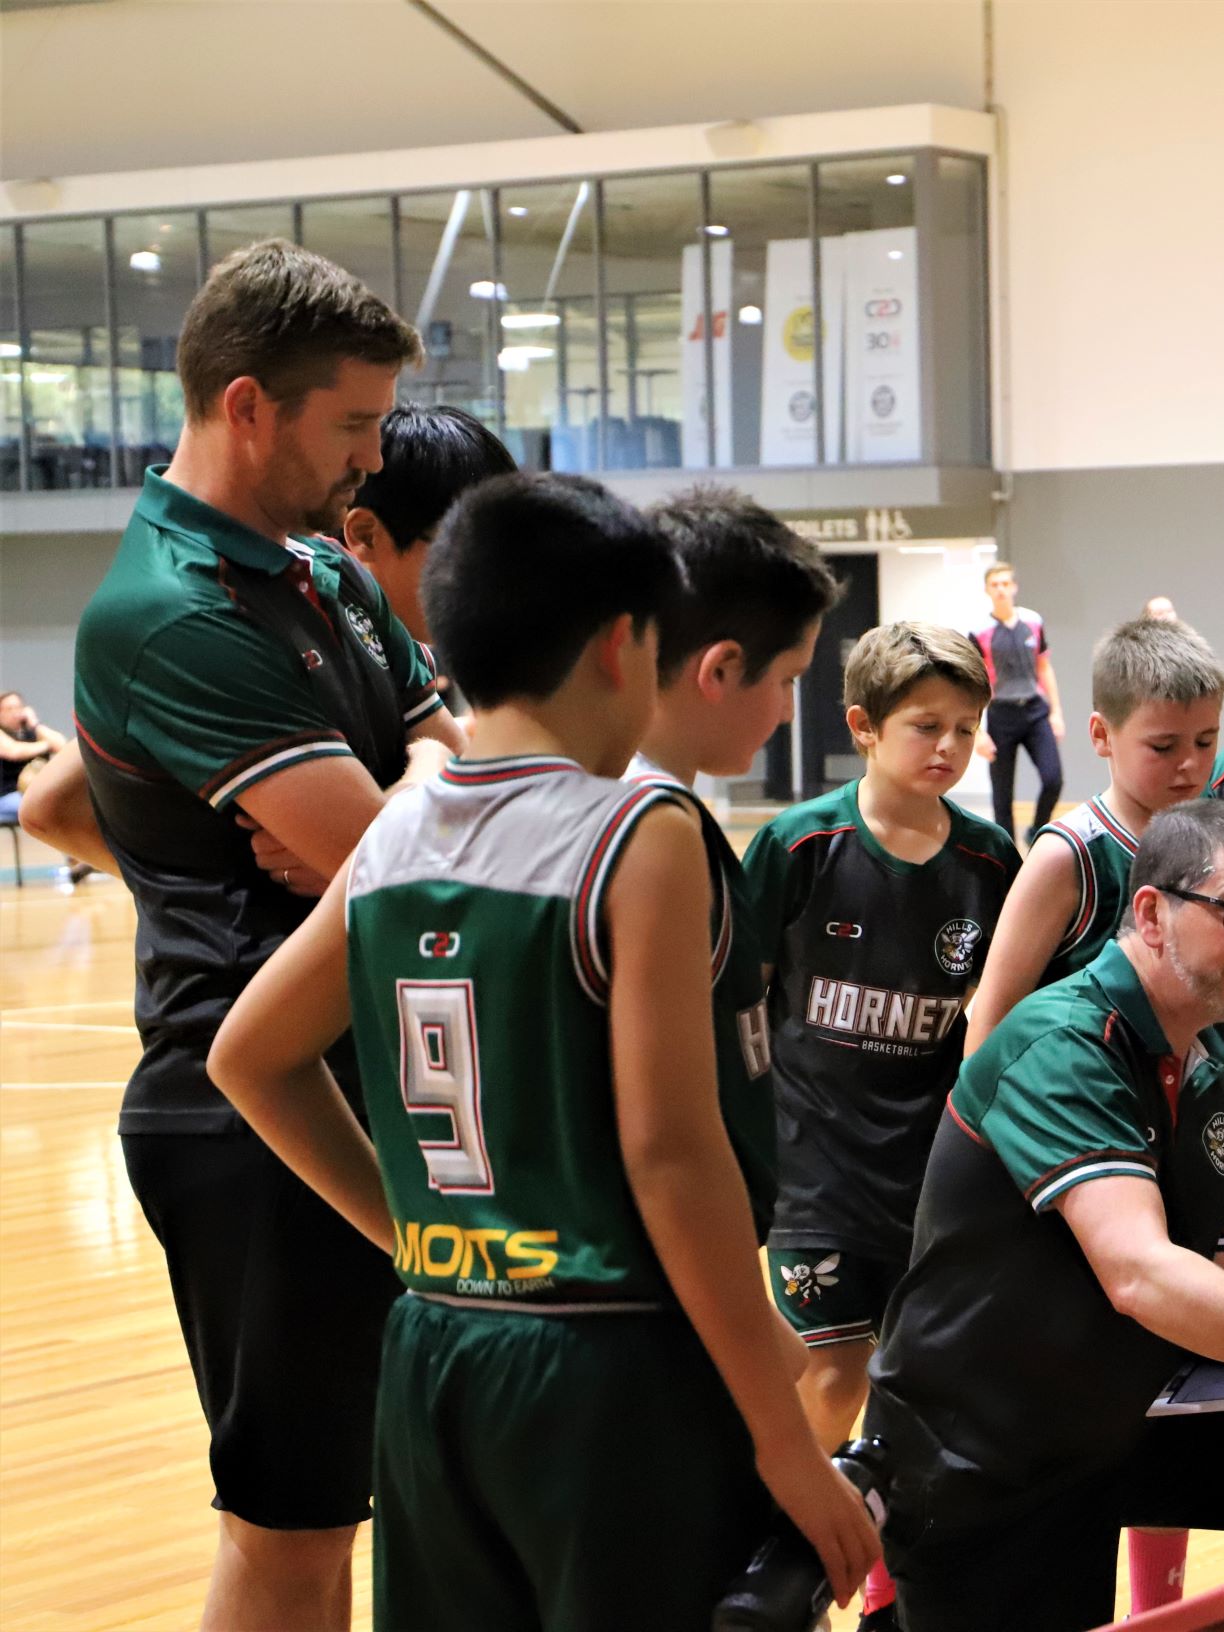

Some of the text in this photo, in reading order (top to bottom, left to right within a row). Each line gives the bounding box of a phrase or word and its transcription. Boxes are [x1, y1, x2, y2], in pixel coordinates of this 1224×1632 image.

[784, 518, 858, 538] OILETS
[946, 923, 973, 934] HILLS
[940, 955, 974, 971] HORNET
[806, 976, 963, 1043] HORNET
[861, 1040, 919, 1057] BASKETBALL
[396, 979, 494, 1195] 9
[456, 1277, 555, 1295] DOWN TO EARTH
